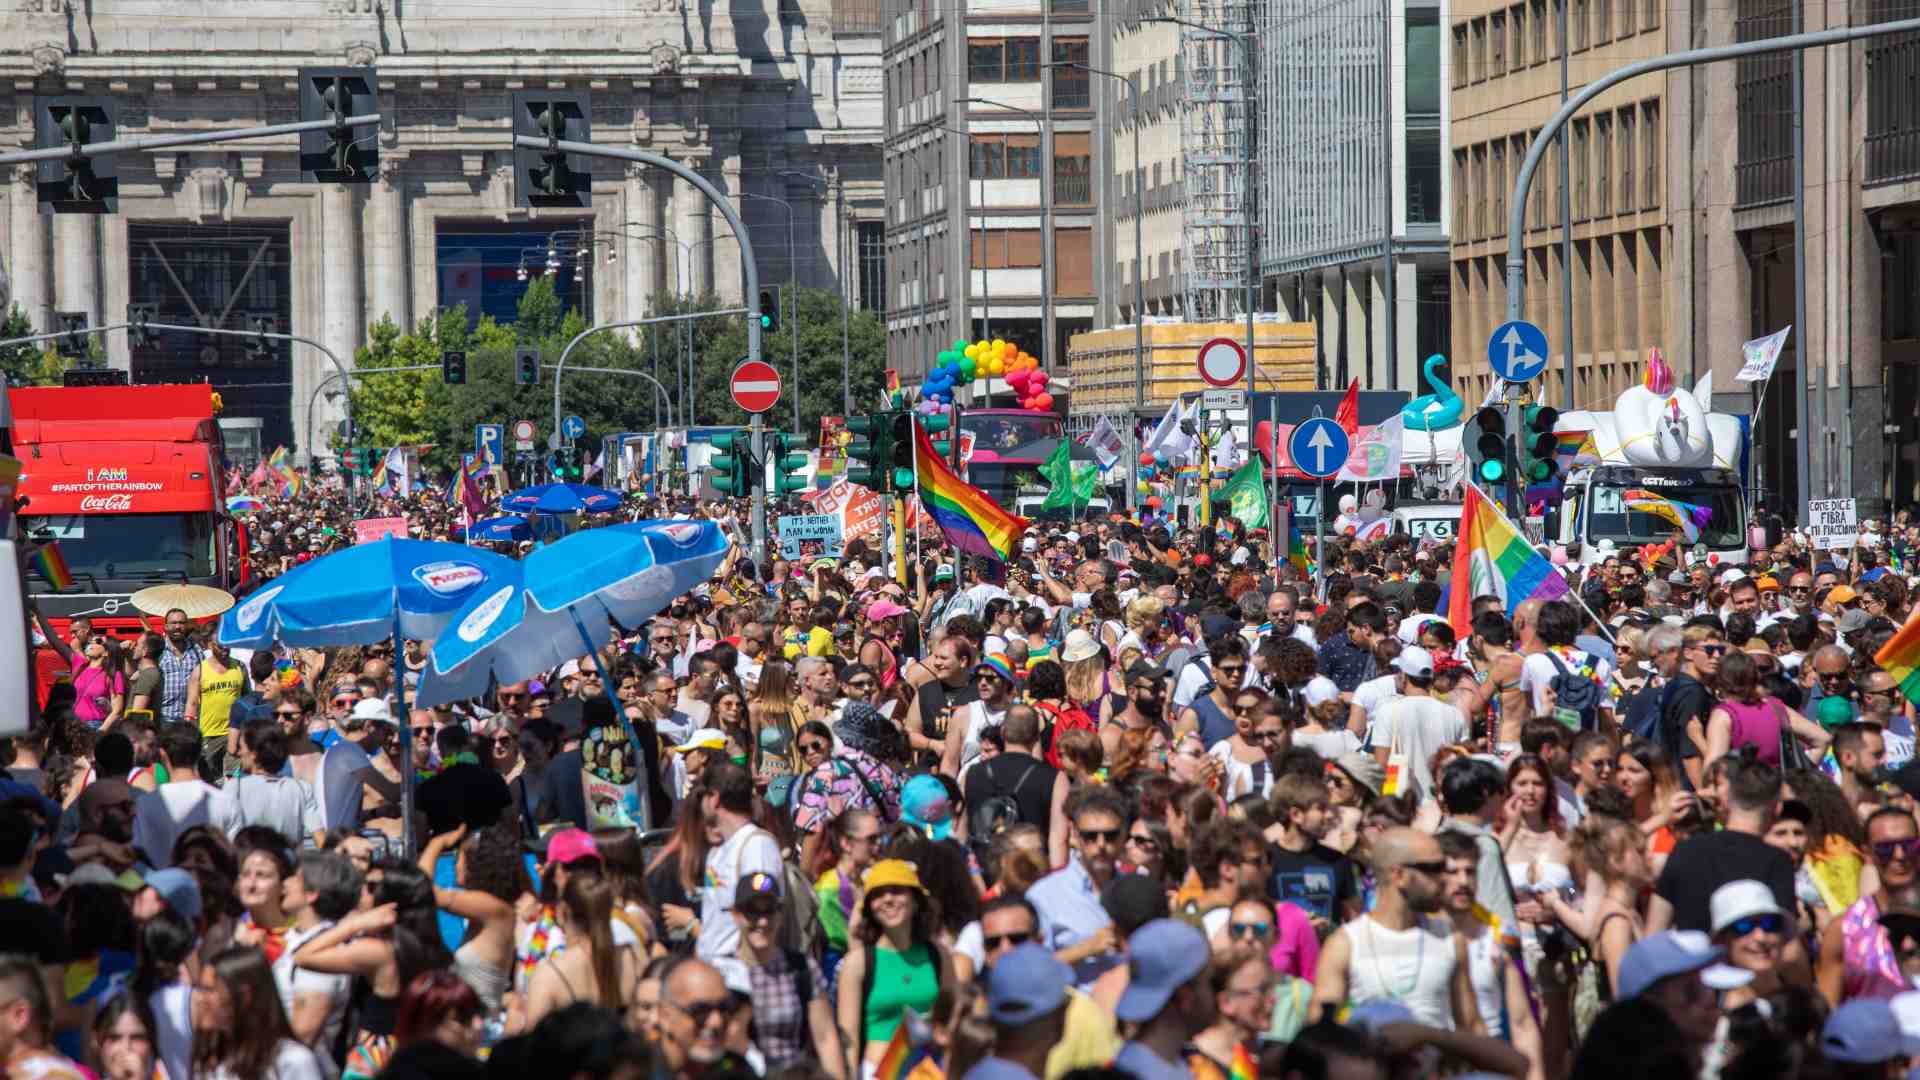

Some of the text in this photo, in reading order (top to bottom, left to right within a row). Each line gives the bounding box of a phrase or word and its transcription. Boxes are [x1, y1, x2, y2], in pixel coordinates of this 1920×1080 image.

[482, 428, 497, 446] P
[87, 467, 128, 481] I AM
[51, 482, 163, 492] #PARTOFTHERAINBOW
[1821, 511, 1846, 524] FIBRA
[785, 527, 803, 537] MAN
[1417, 521, 1448, 536] 16
